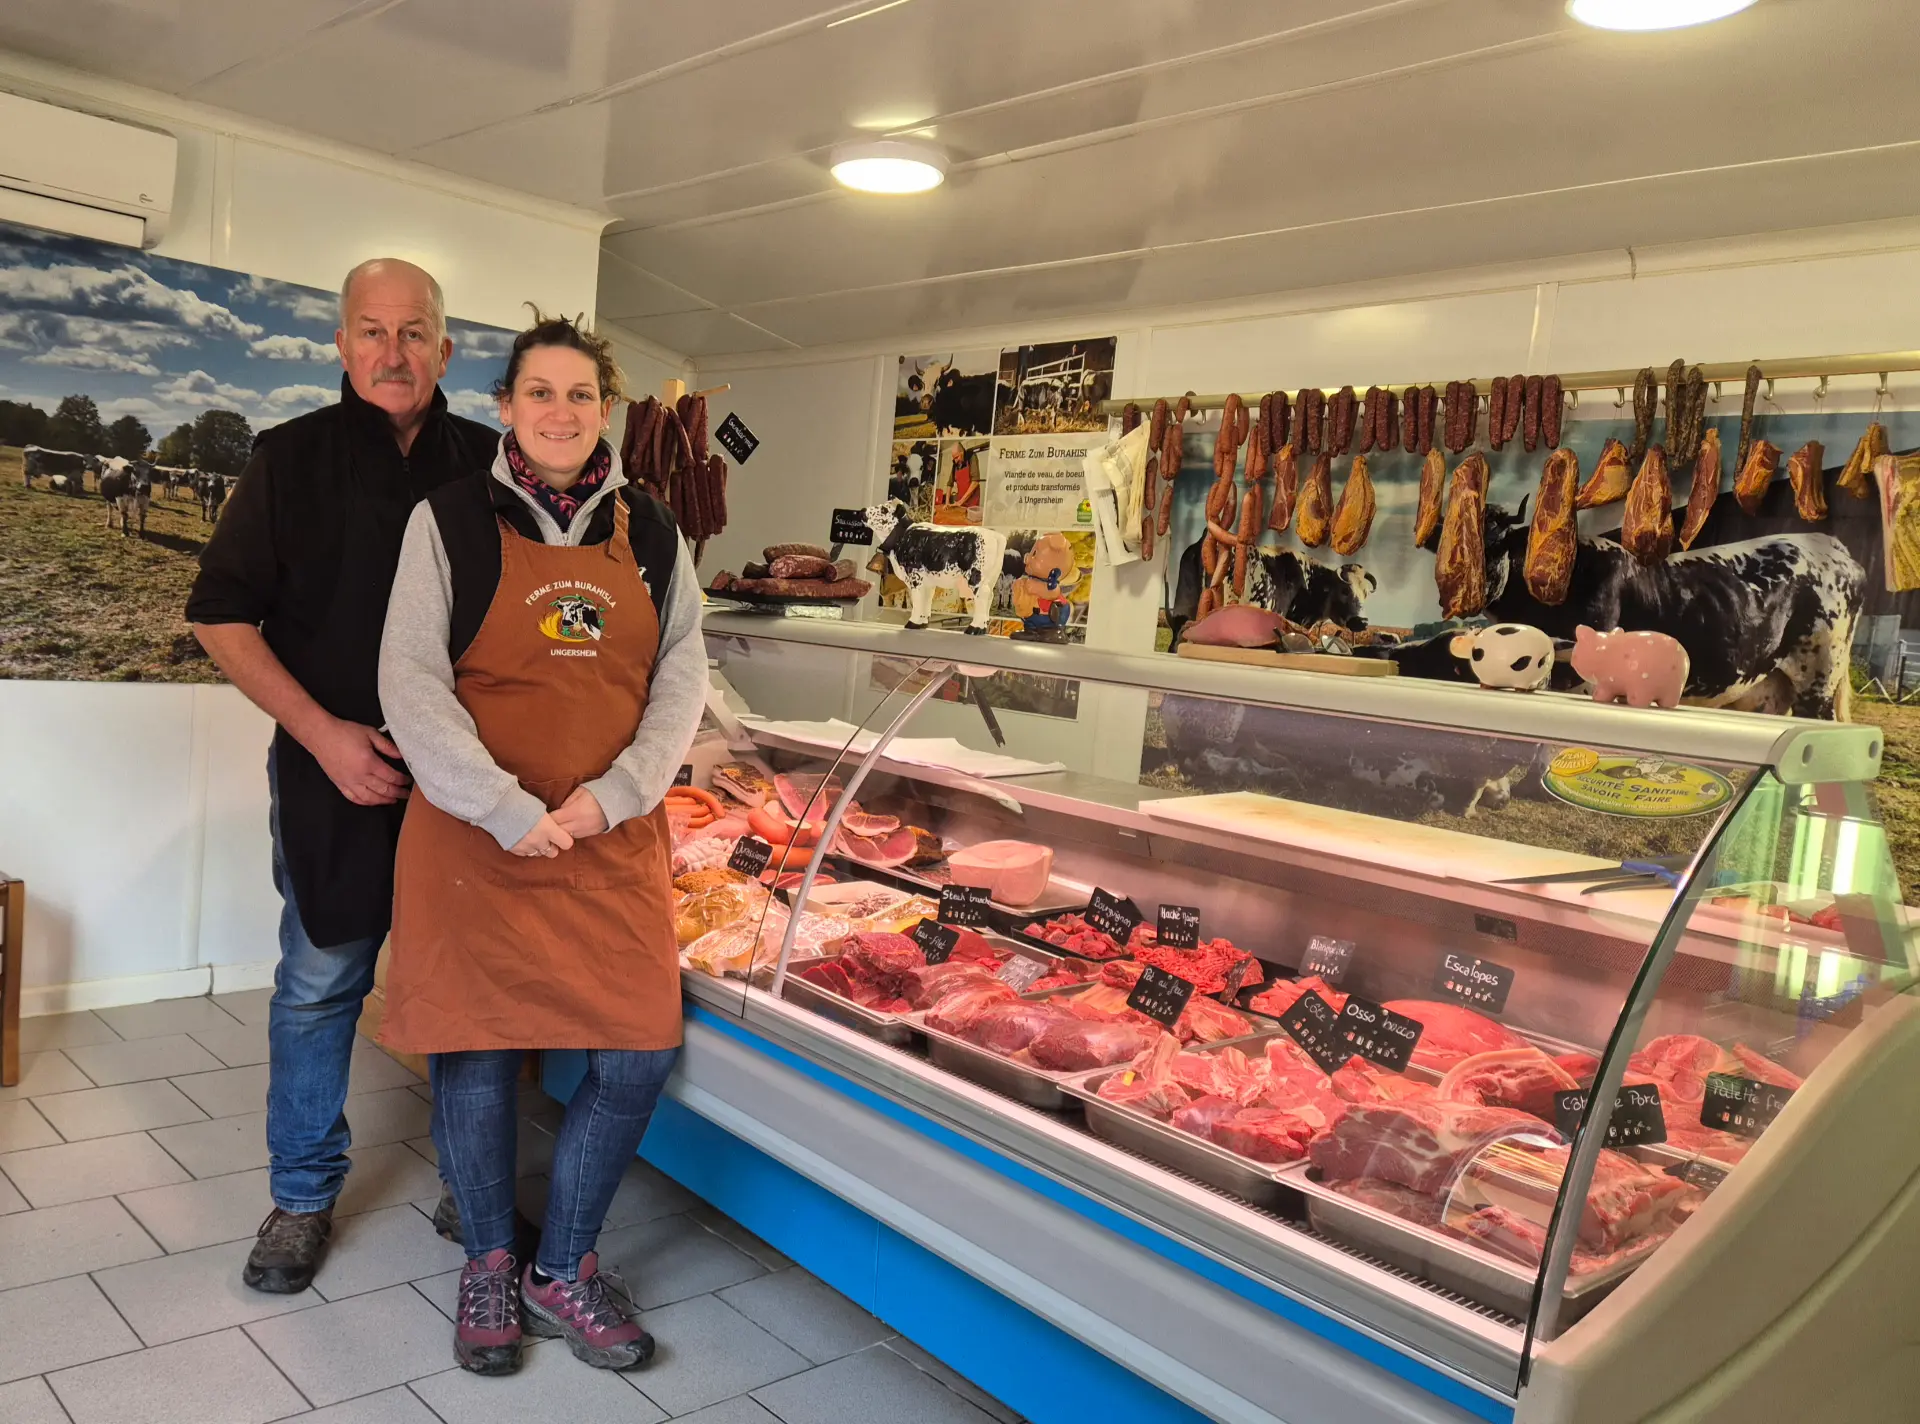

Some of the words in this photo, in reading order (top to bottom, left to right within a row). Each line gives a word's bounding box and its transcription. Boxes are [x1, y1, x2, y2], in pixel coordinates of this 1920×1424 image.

[999, 447, 1026, 459] FERME
[1028, 448, 1045, 459] ZUM
[1004, 470, 1026, 479] Viande
[1027, 470, 1036, 479] de
[1037, 471, 1055, 479] veau,
[1055, 470, 1064, 478] de
[1013, 483, 1040, 492] produits
[1040, 483, 1081, 491] transformés
[1024, 496, 1064, 505] Ungersheim
[525, 584, 552, 606] FERME
[553, 580, 573, 590] ZUM
[574, 580, 617, 609] BURAHISLA
[550, 648, 598, 657] UNGERSHEIM
[1580, 782, 1622, 800] SAVOIR
[1633, 793, 1673, 804] FAIRE
[1628, 783, 1691, 797] SANITAIRE
[1444, 954, 1499, 986] Escalopes
[1158, 979, 1169, 990] au
[1166, 978, 1185, 998] feu
[1346, 1003, 1376, 1024] Osso
[1562, 1095, 1589, 1111] Côt
